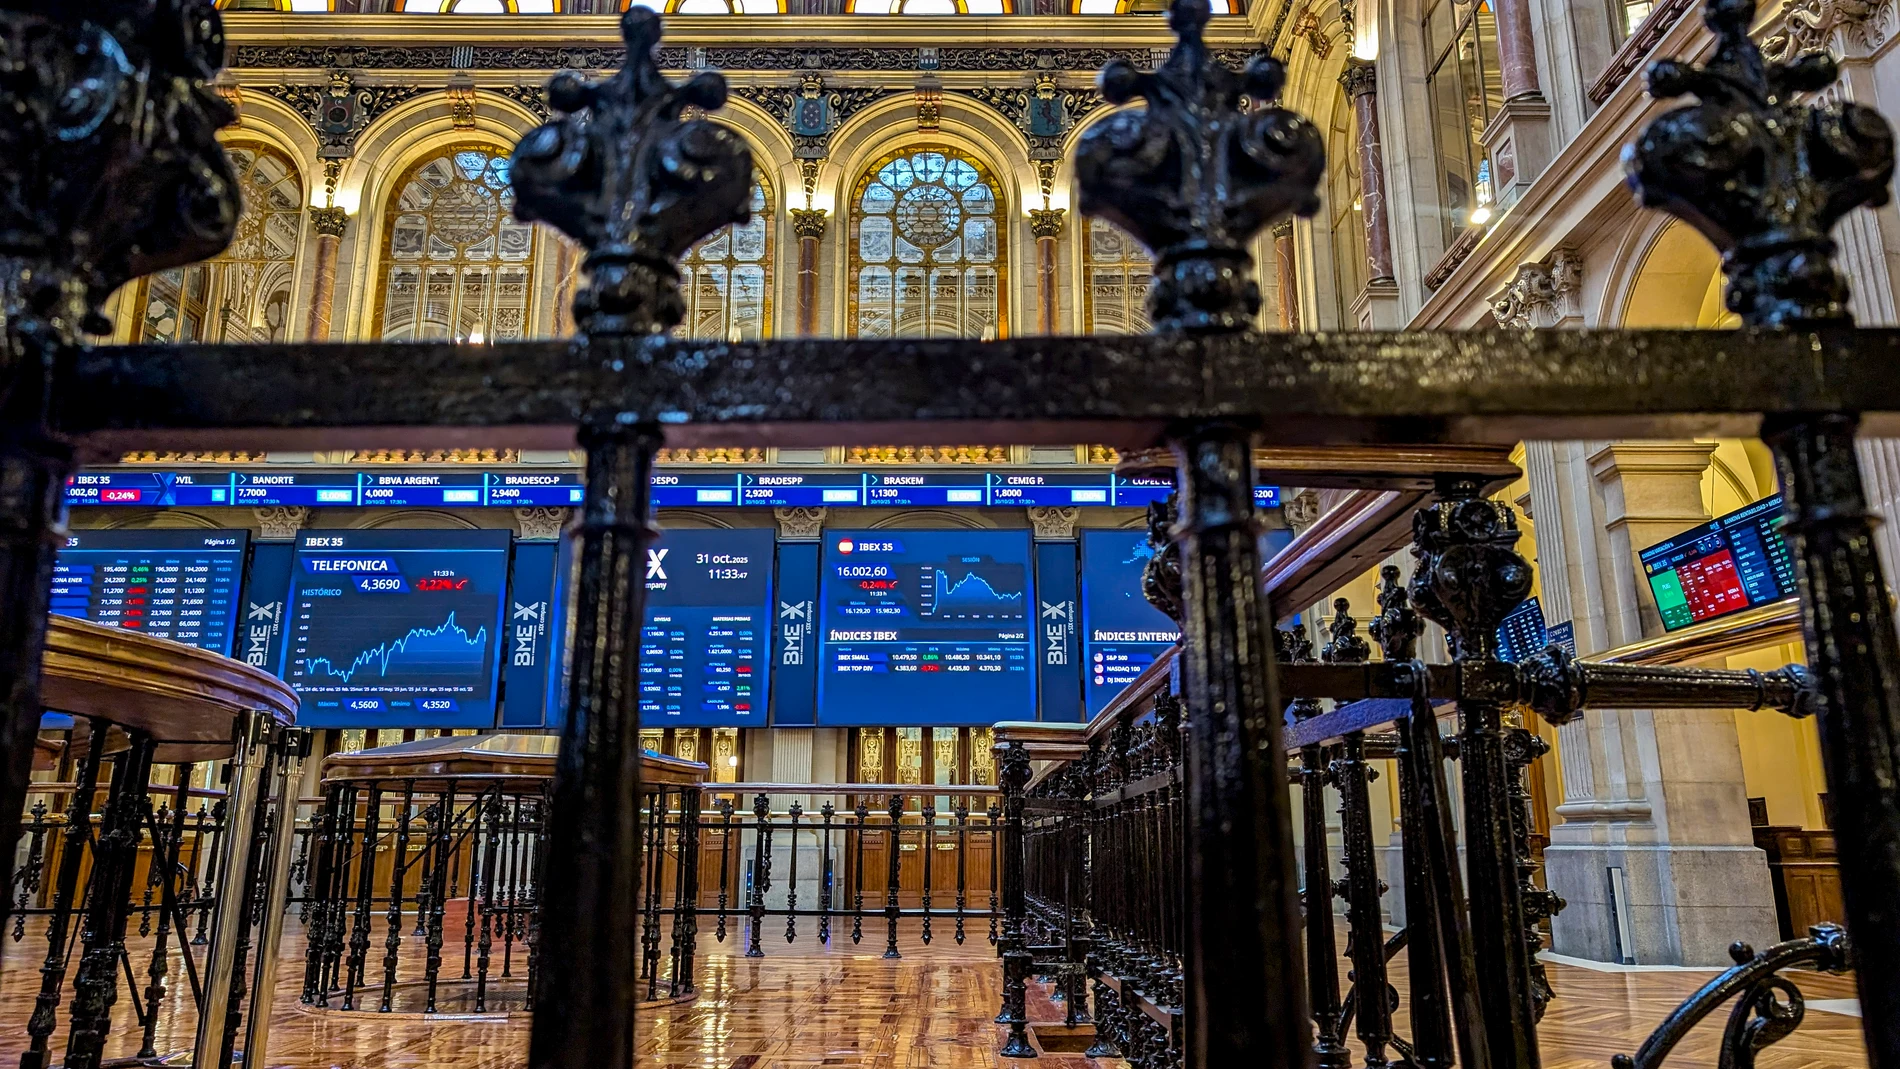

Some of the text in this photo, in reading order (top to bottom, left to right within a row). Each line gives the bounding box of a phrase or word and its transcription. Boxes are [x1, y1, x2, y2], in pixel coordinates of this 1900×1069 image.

[253, 476, 293, 484] BANORTE
[759, 477, 802, 485] BRADESPP
[107, 492, 135, 500] -0,24%
[238, 489, 267, 497] 7,7000
[365, 489, 393, 498] 4,0000
[492, 489, 520, 498] 2,9400
[745, 490, 773, 498] 2,9200
[871, 489, 898, 498] 1,1300
[995, 489, 1022, 498] 1,8000
[306, 538, 343, 546] IBEX 35
[859, 543, 893, 551] IBEX 35
[696, 554, 748, 563] 31 oct.2025
[312, 560, 388, 571] TELEFONICA
[709, 569, 747, 579] 11:33:47
[837, 567, 887, 577] 16.002,60
[361, 579, 400, 591] 4,3690
[859, 581, 887, 589] -0,24%
[302, 588, 342, 596] HISTÓRICO
[830, 630, 871, 641] ÍNDICES
[874, 632, 897, 640] IBEX
[1094, 630, 1136, 641] ÍNDICES
[247, 625, 267, 666] BME
[514, 625, 533, 666] BME
[783, 624, 800, 665] BME
[1047, 624, 1063, 665] BME
[351, 701, 378, 709] 4,5600
[423, 701, 450, 709] 4,3520
